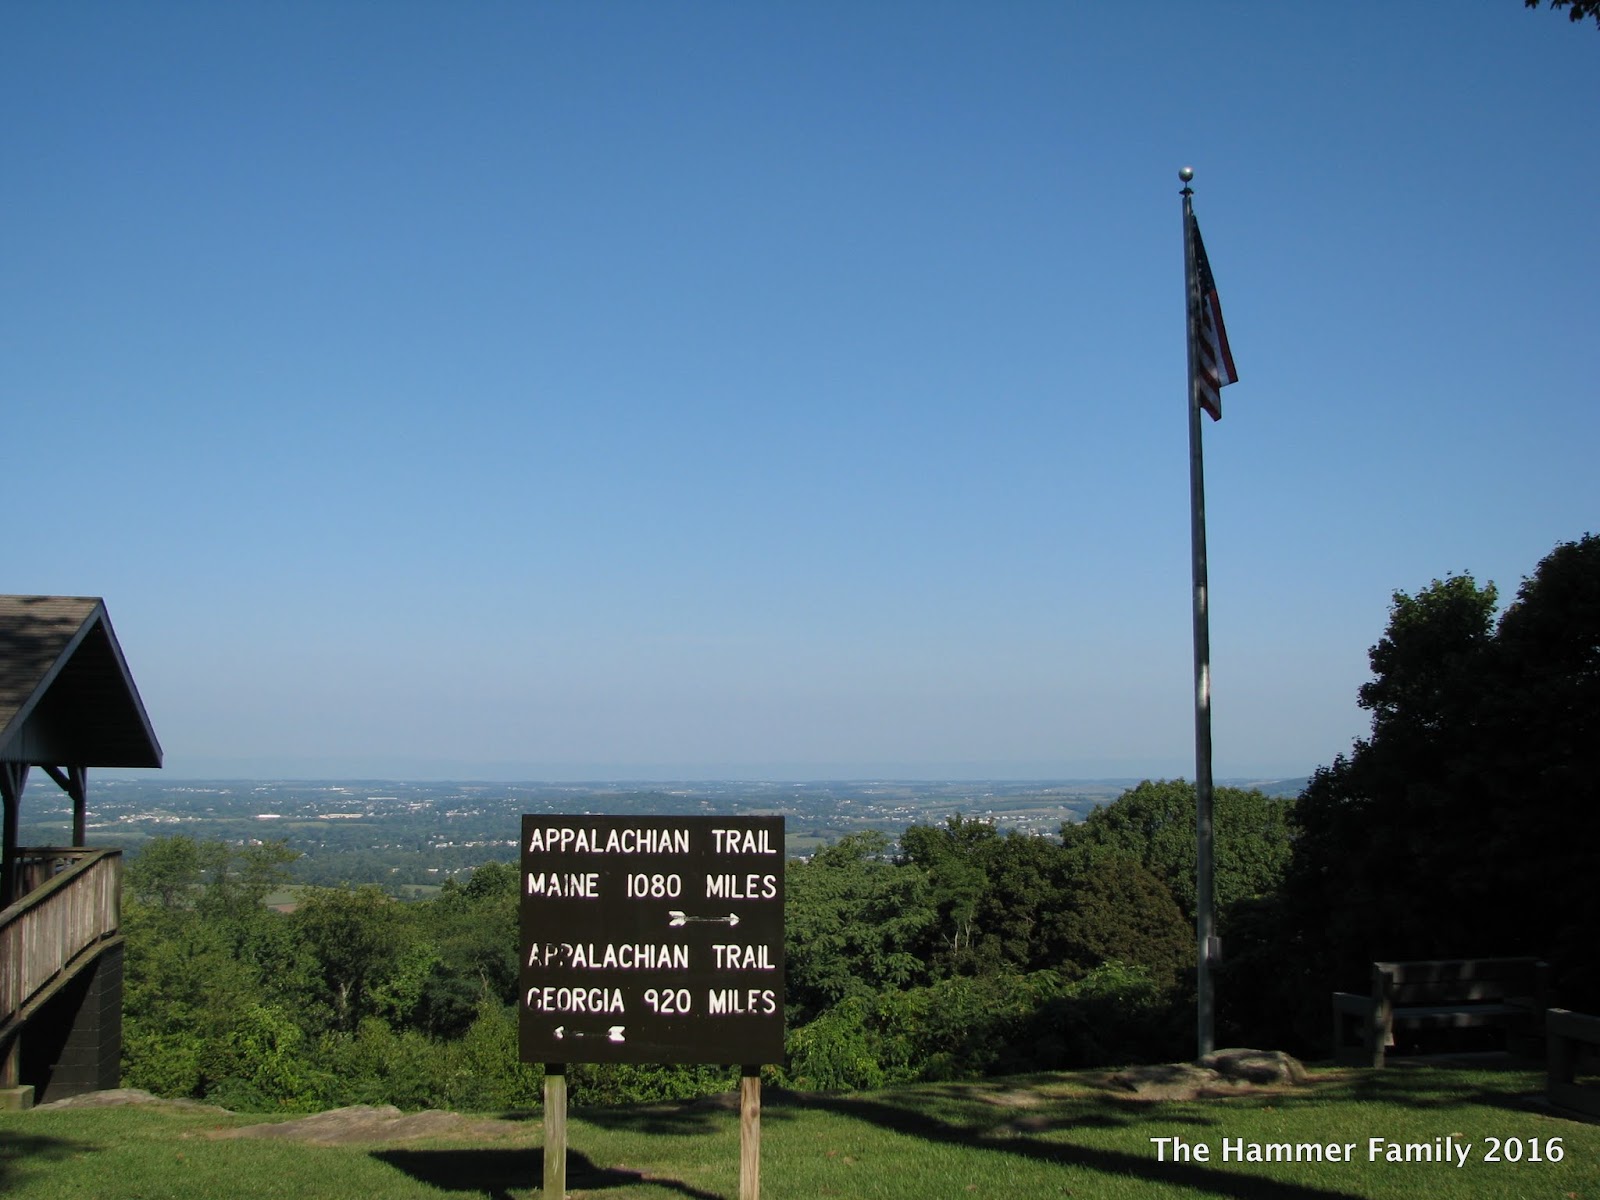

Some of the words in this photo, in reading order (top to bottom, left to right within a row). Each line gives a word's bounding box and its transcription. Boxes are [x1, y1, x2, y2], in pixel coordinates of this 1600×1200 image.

[528, 828, 690, 855] APPALACHIAN
[711, 829, 778, 855] TRAIL
[528, 872, 600, 898] MAINE
[626, 873, 683, 899] 1080
[706, 874, 778, 900] MILES
[711, 943, 777, 970] TRAIL
[526, 986, 626, 1014] GEORGIA
[643, 987, 693, 1015] 920
[708, 988, 777, 1015] MILES
